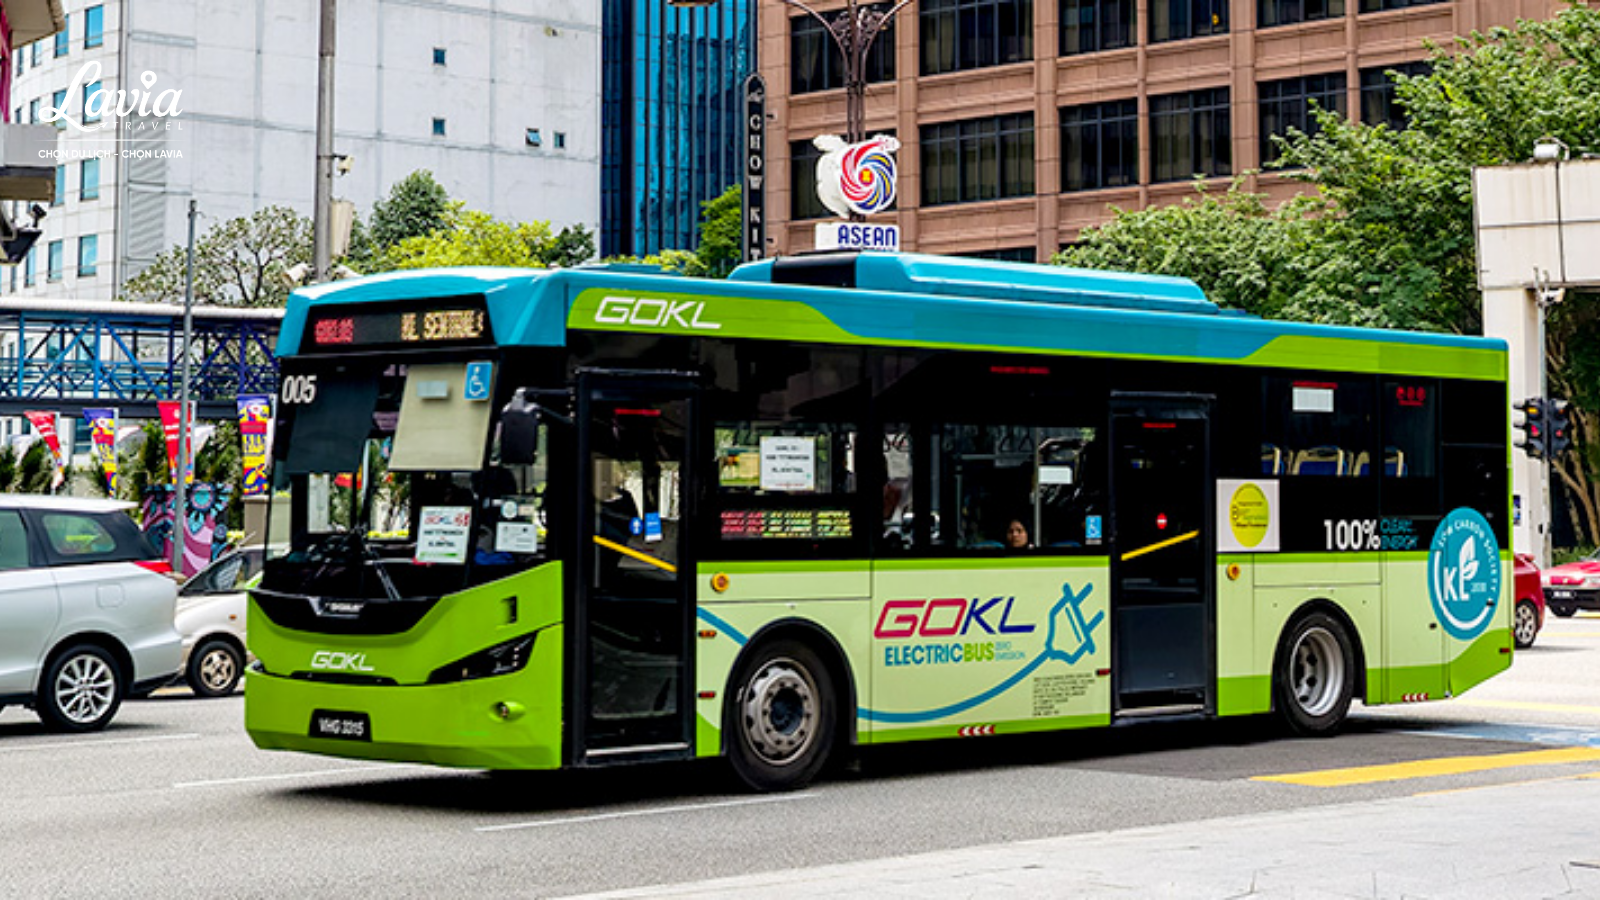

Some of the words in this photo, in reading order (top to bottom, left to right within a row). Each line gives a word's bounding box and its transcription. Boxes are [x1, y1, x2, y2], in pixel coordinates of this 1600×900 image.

[749, 114, 762, 190] CHOW
[838, 224, 896, 246] ASEAN
[594, 295, 722, 330] GOKL
[281, 374, 317, 404] 005
[1324, 519, 1380, 550] 100%
[874, 596, 1036, 639] GOKL
[311, 650, 375, 672] GOKL
